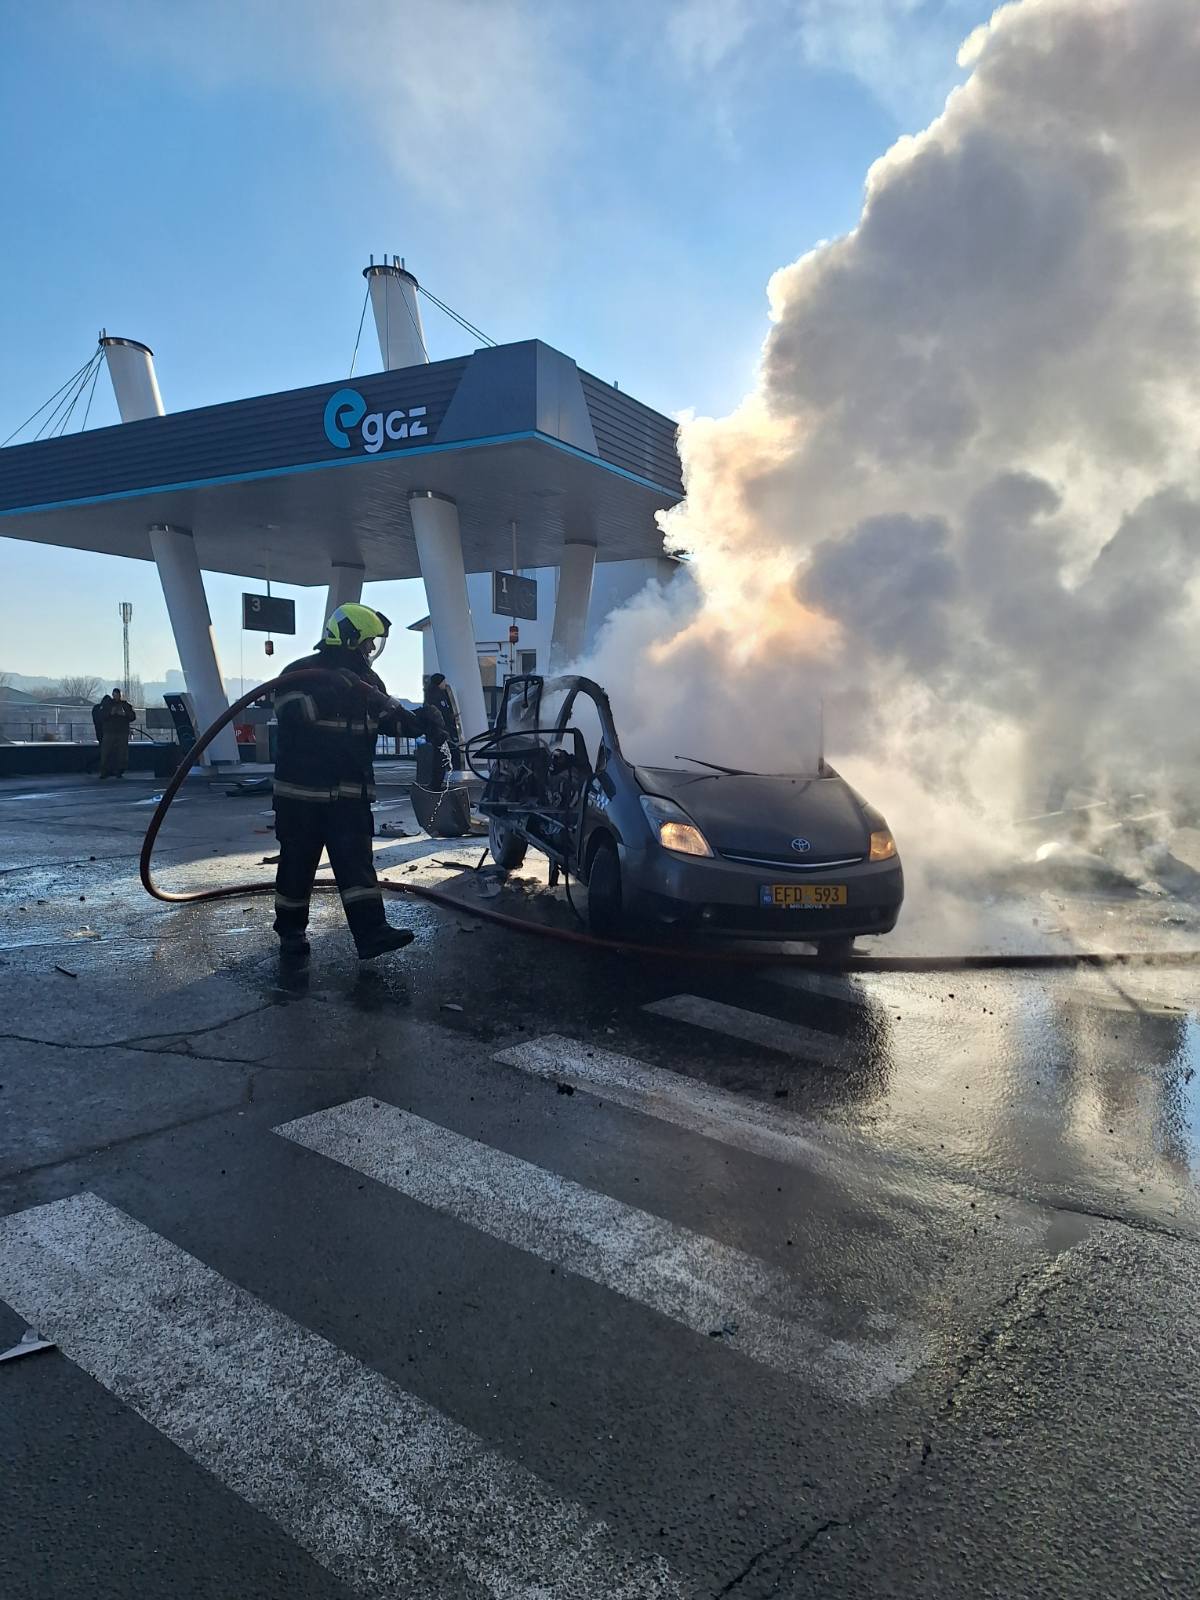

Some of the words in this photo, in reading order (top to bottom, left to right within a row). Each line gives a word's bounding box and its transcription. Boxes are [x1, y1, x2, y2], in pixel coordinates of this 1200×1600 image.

[502, 577, 508, 593] 1
[251, 598, 261, 611] 3
[774, 887, 802, 902] EFD
[815, 887, 839, 902] 593
